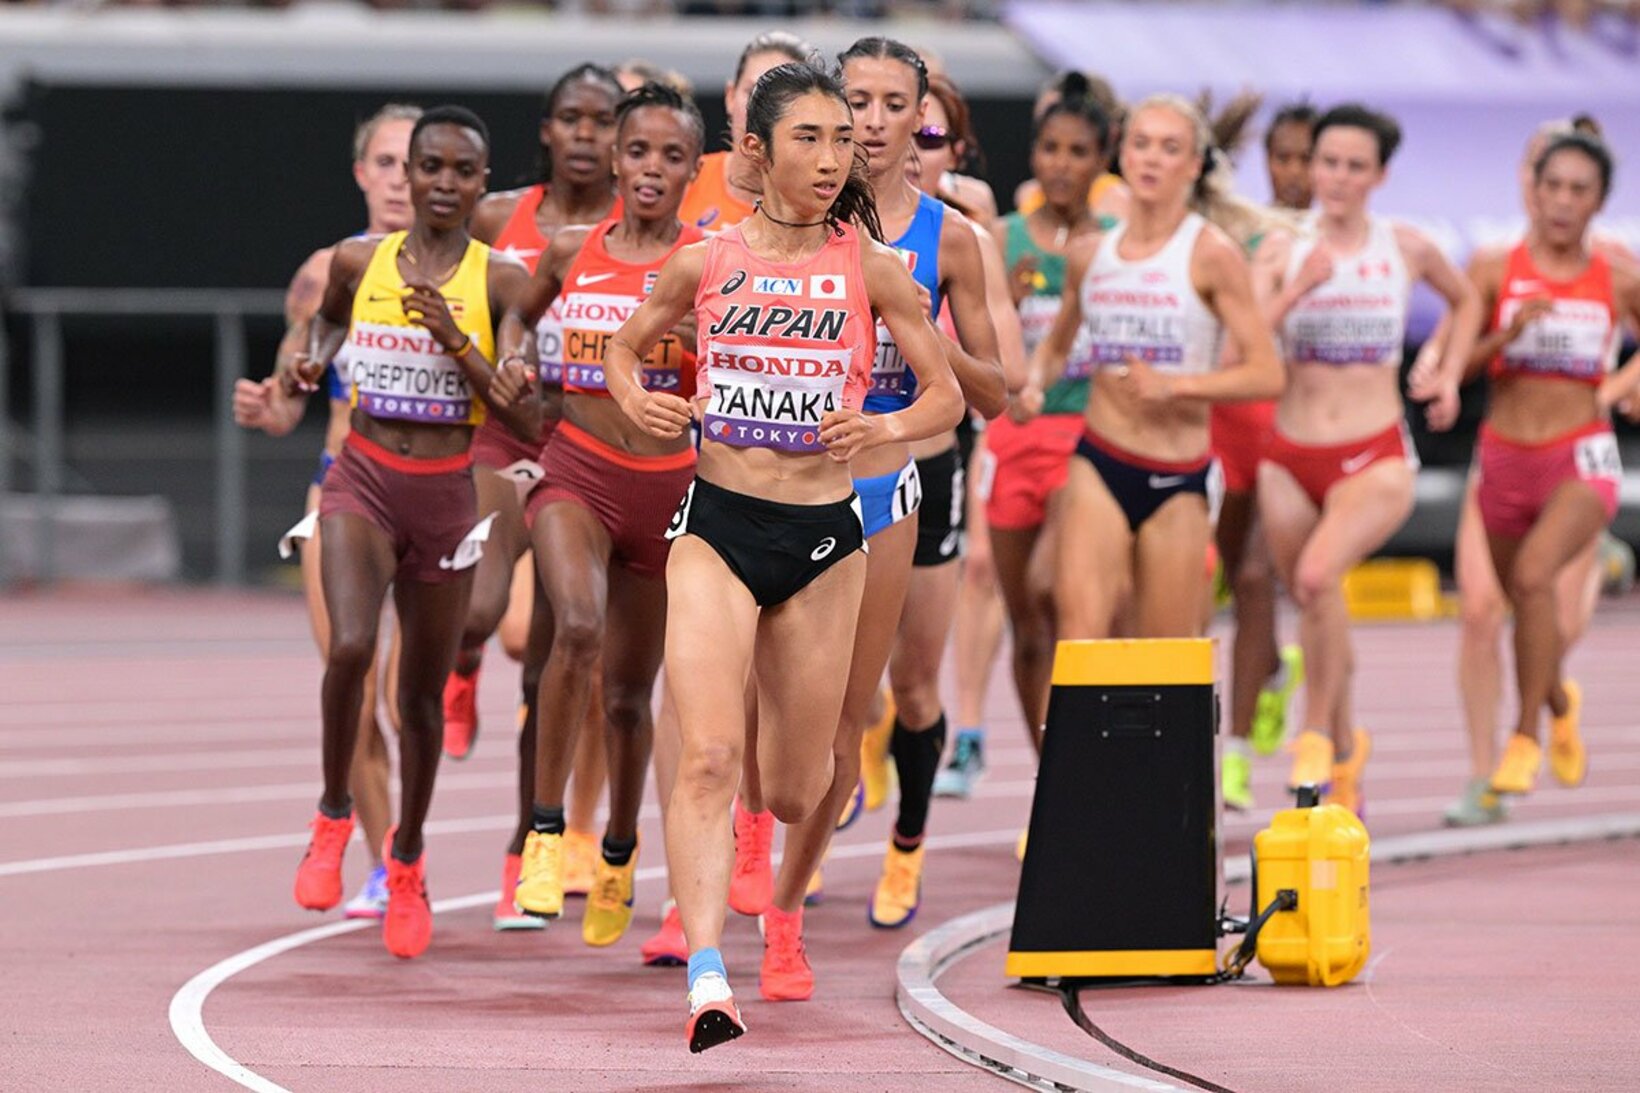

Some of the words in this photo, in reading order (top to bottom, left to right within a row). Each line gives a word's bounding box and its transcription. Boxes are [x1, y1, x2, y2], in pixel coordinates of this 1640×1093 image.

[756, 278, 799, 294] ACN
[565, 303, 633, 322] HON
[709, 304, 848, 342] JAPAN
[354, 330, 445, 355] HOND
[710, 350, 846, 378] HONDA
[713, 383, 836, 423] TANAKA
